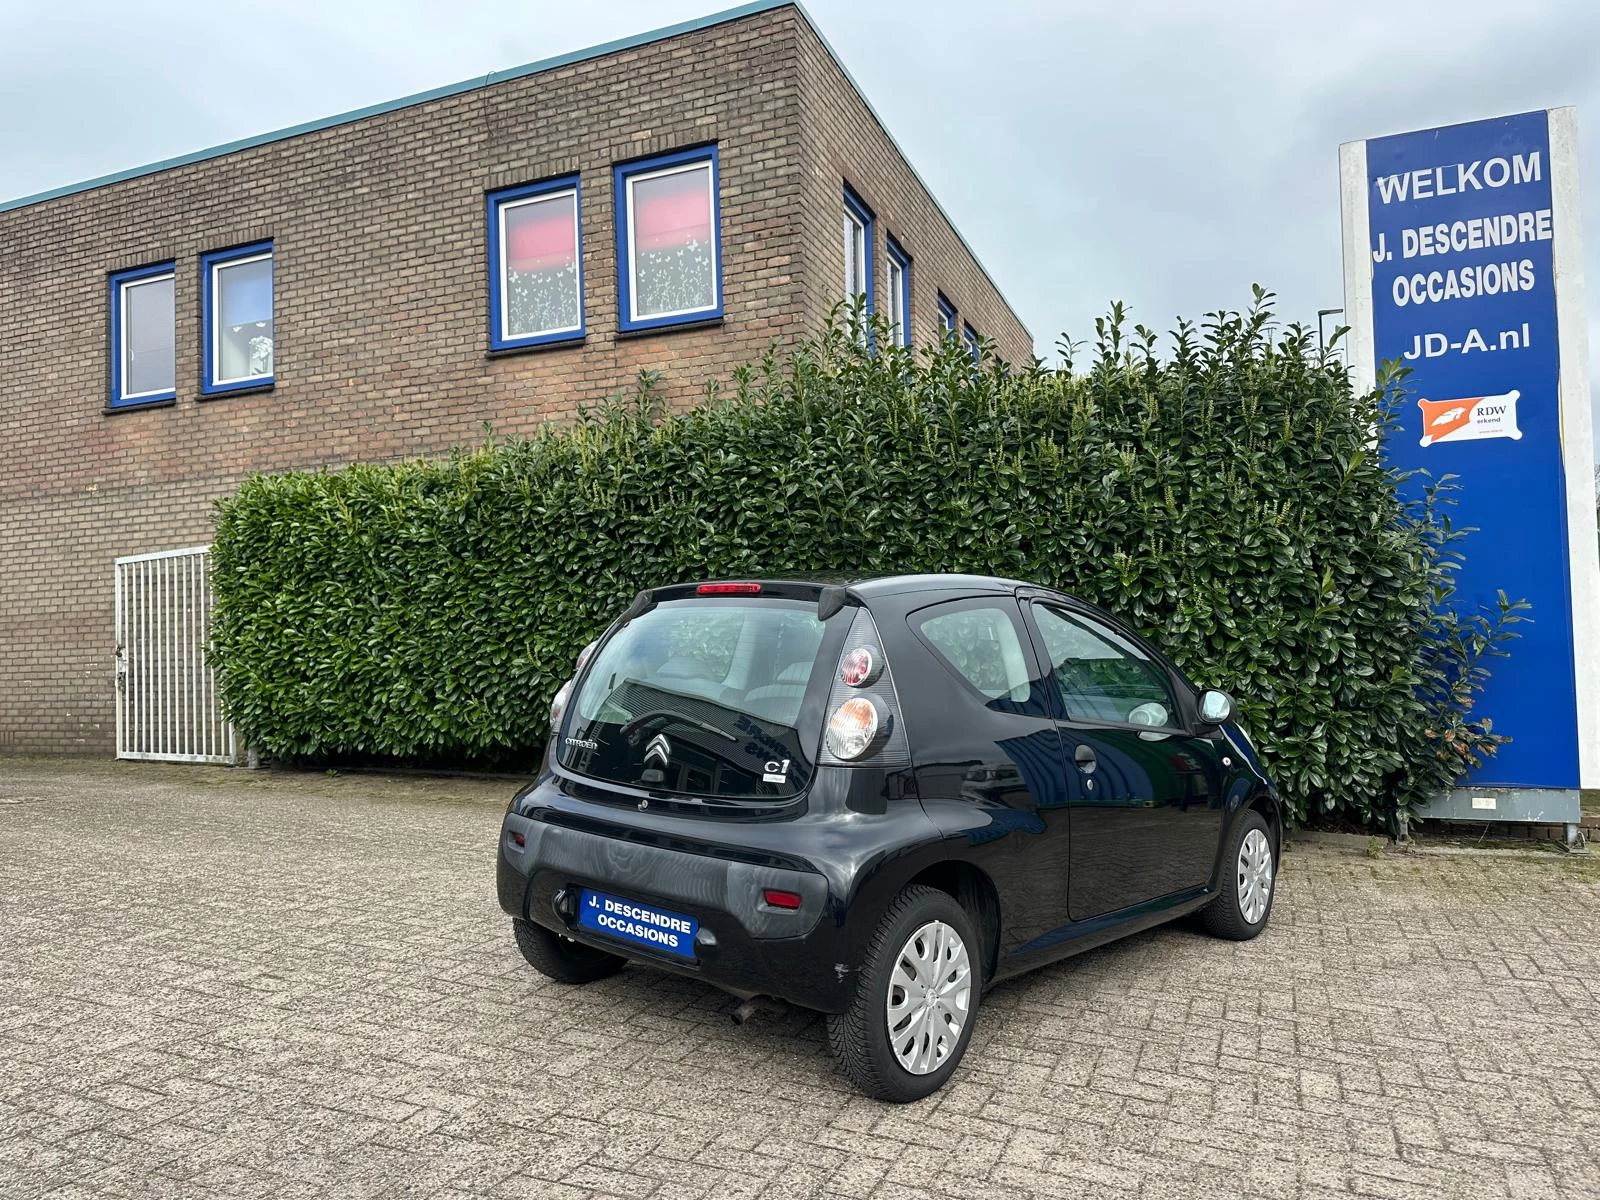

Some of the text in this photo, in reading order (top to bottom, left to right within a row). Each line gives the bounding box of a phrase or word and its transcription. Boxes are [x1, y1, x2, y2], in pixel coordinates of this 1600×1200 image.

[1377, 151, 1541, 204] WELKOM
[1372, 209, 1552, 263] J. DESCENDRE
[1392, 259, 1535, 307] OCCASIONS
[1403, 322, 1530, 360] JD-A.nl
[1476, 405, 1507, 417] RDW
[1476, 416, 1501, 424] erkend
[588, 895, 692, 935] J. DESCENDRE
[597, 914, 679, 948] OCCASIONS
